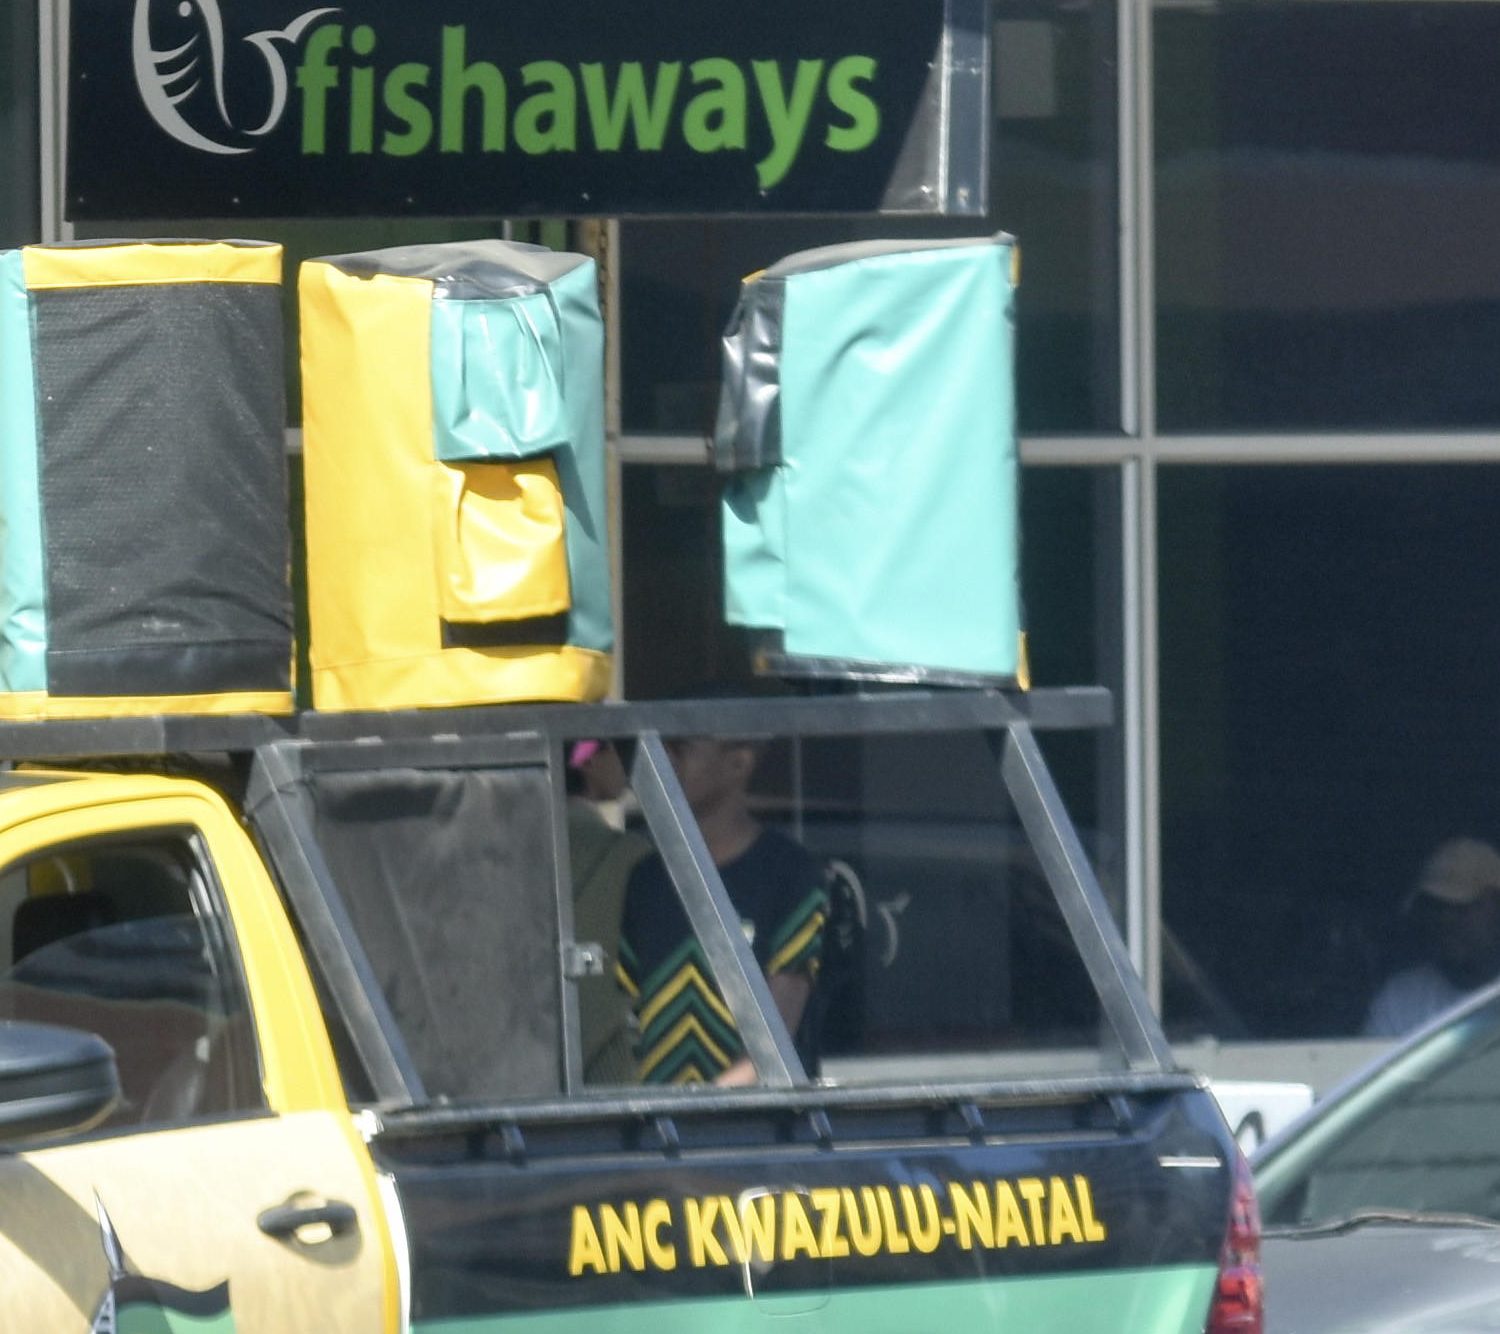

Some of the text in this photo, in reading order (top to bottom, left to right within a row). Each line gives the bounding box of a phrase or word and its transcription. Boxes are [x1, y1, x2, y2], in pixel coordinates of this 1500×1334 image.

[295, 23, 881, 190] fishaways
[568, 1174, 1105, 1277] ANC KWAZULU-NATAL
